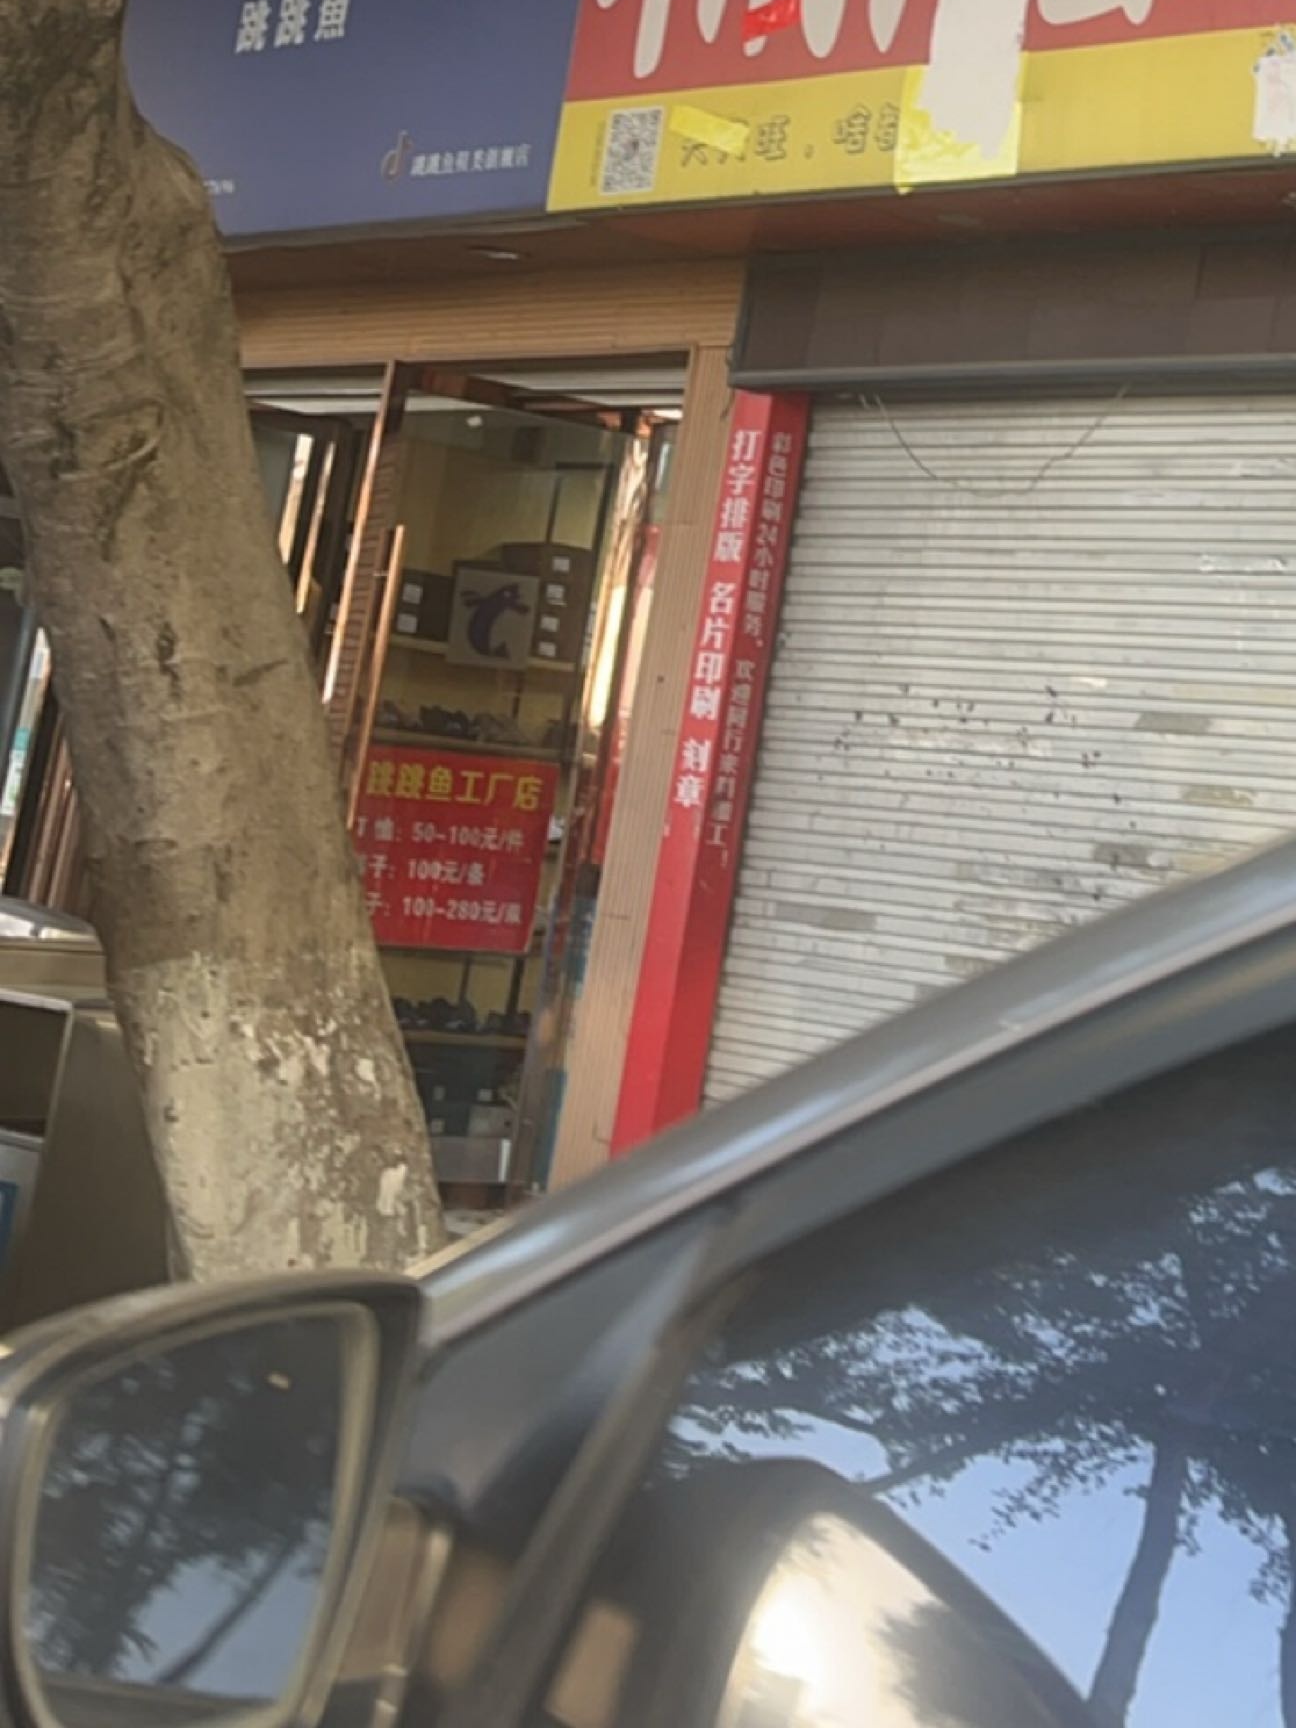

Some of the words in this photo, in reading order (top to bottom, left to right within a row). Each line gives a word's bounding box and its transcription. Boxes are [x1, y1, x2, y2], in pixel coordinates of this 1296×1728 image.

[713, 429, 763, 563] 打字排版
[690, 581, 737, 721] 名片印刷
